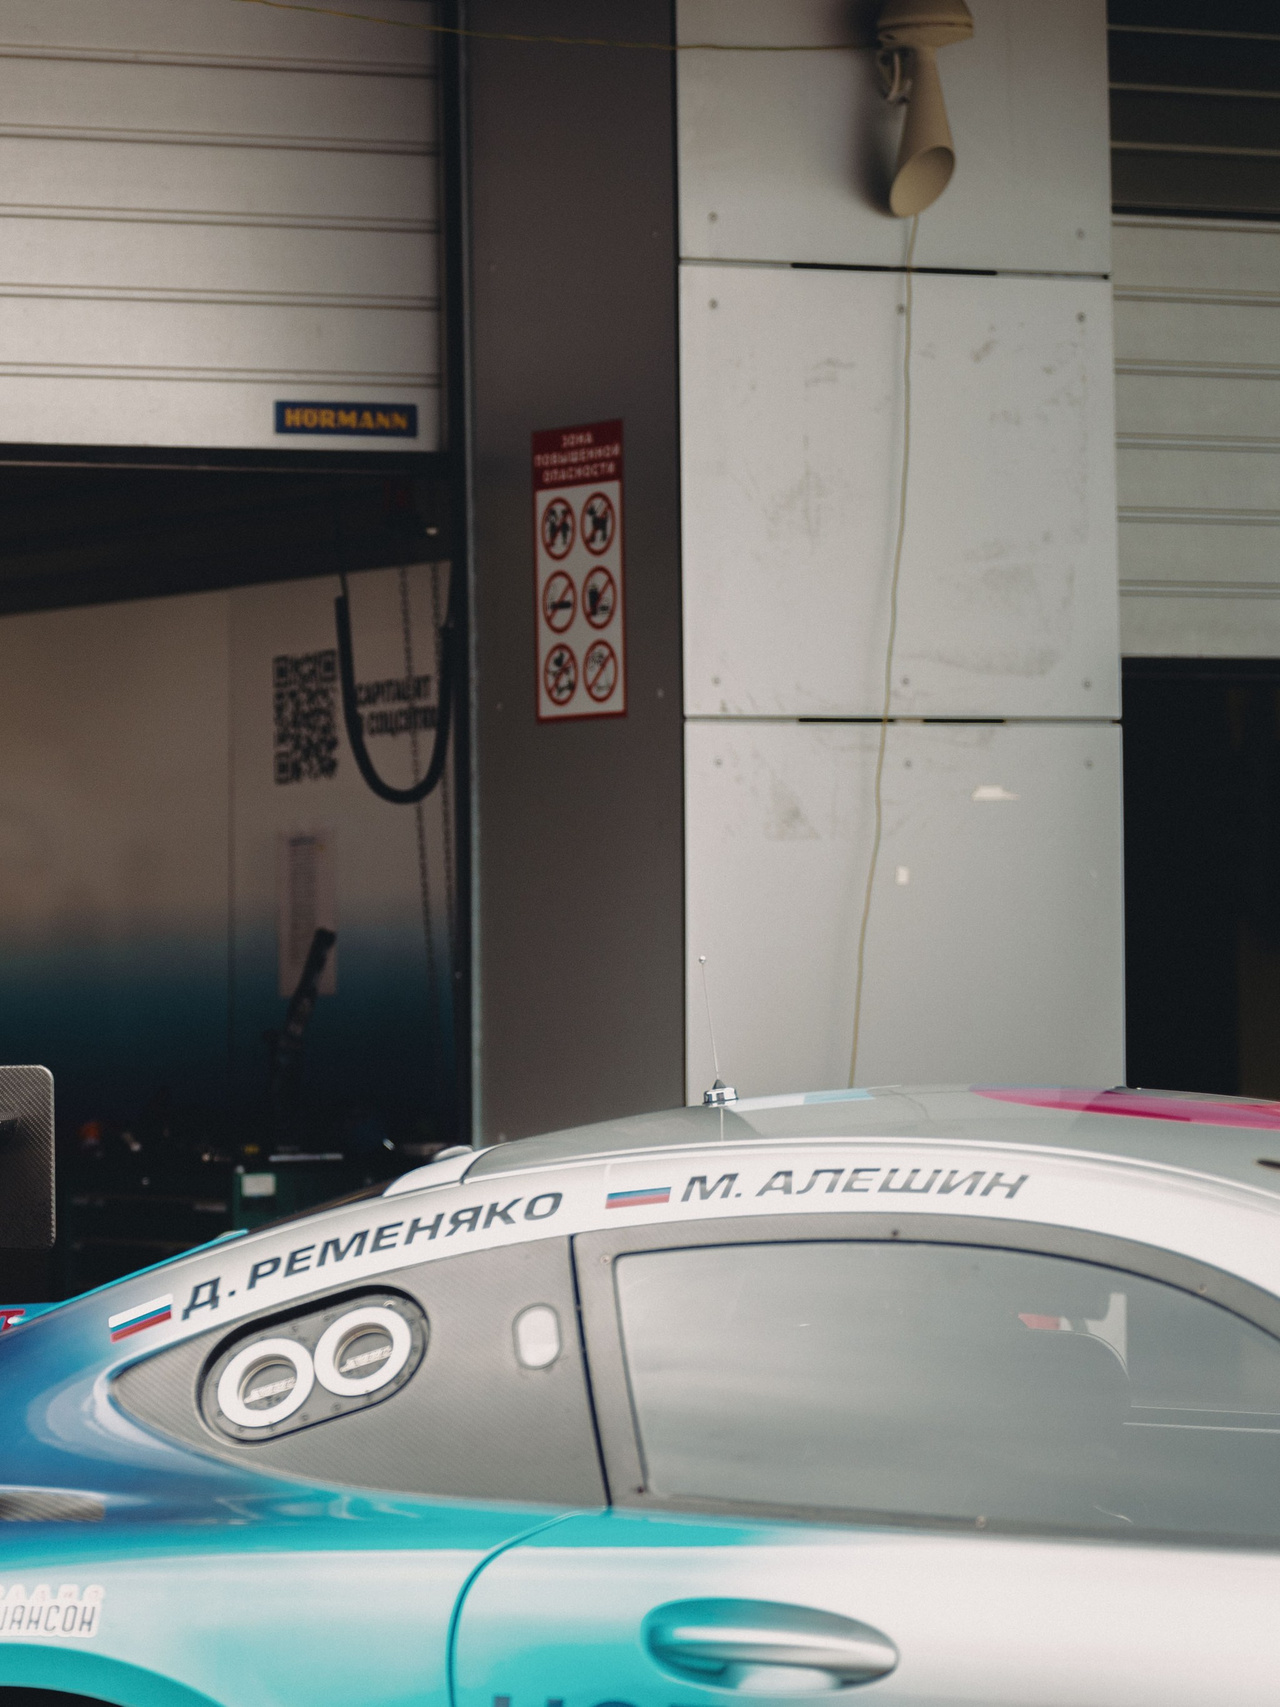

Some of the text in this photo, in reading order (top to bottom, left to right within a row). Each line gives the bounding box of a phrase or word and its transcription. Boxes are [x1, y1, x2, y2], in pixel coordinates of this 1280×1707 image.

[561, 432, 593, 448] ЗОНА
[542, 461, 616, 484] ОПАСНОСТИ
[681, 1167, 1030, 1202] М. АЛЕШИН
[181, 1192, 563, 1321] Д. РЕМЕНЯКО
